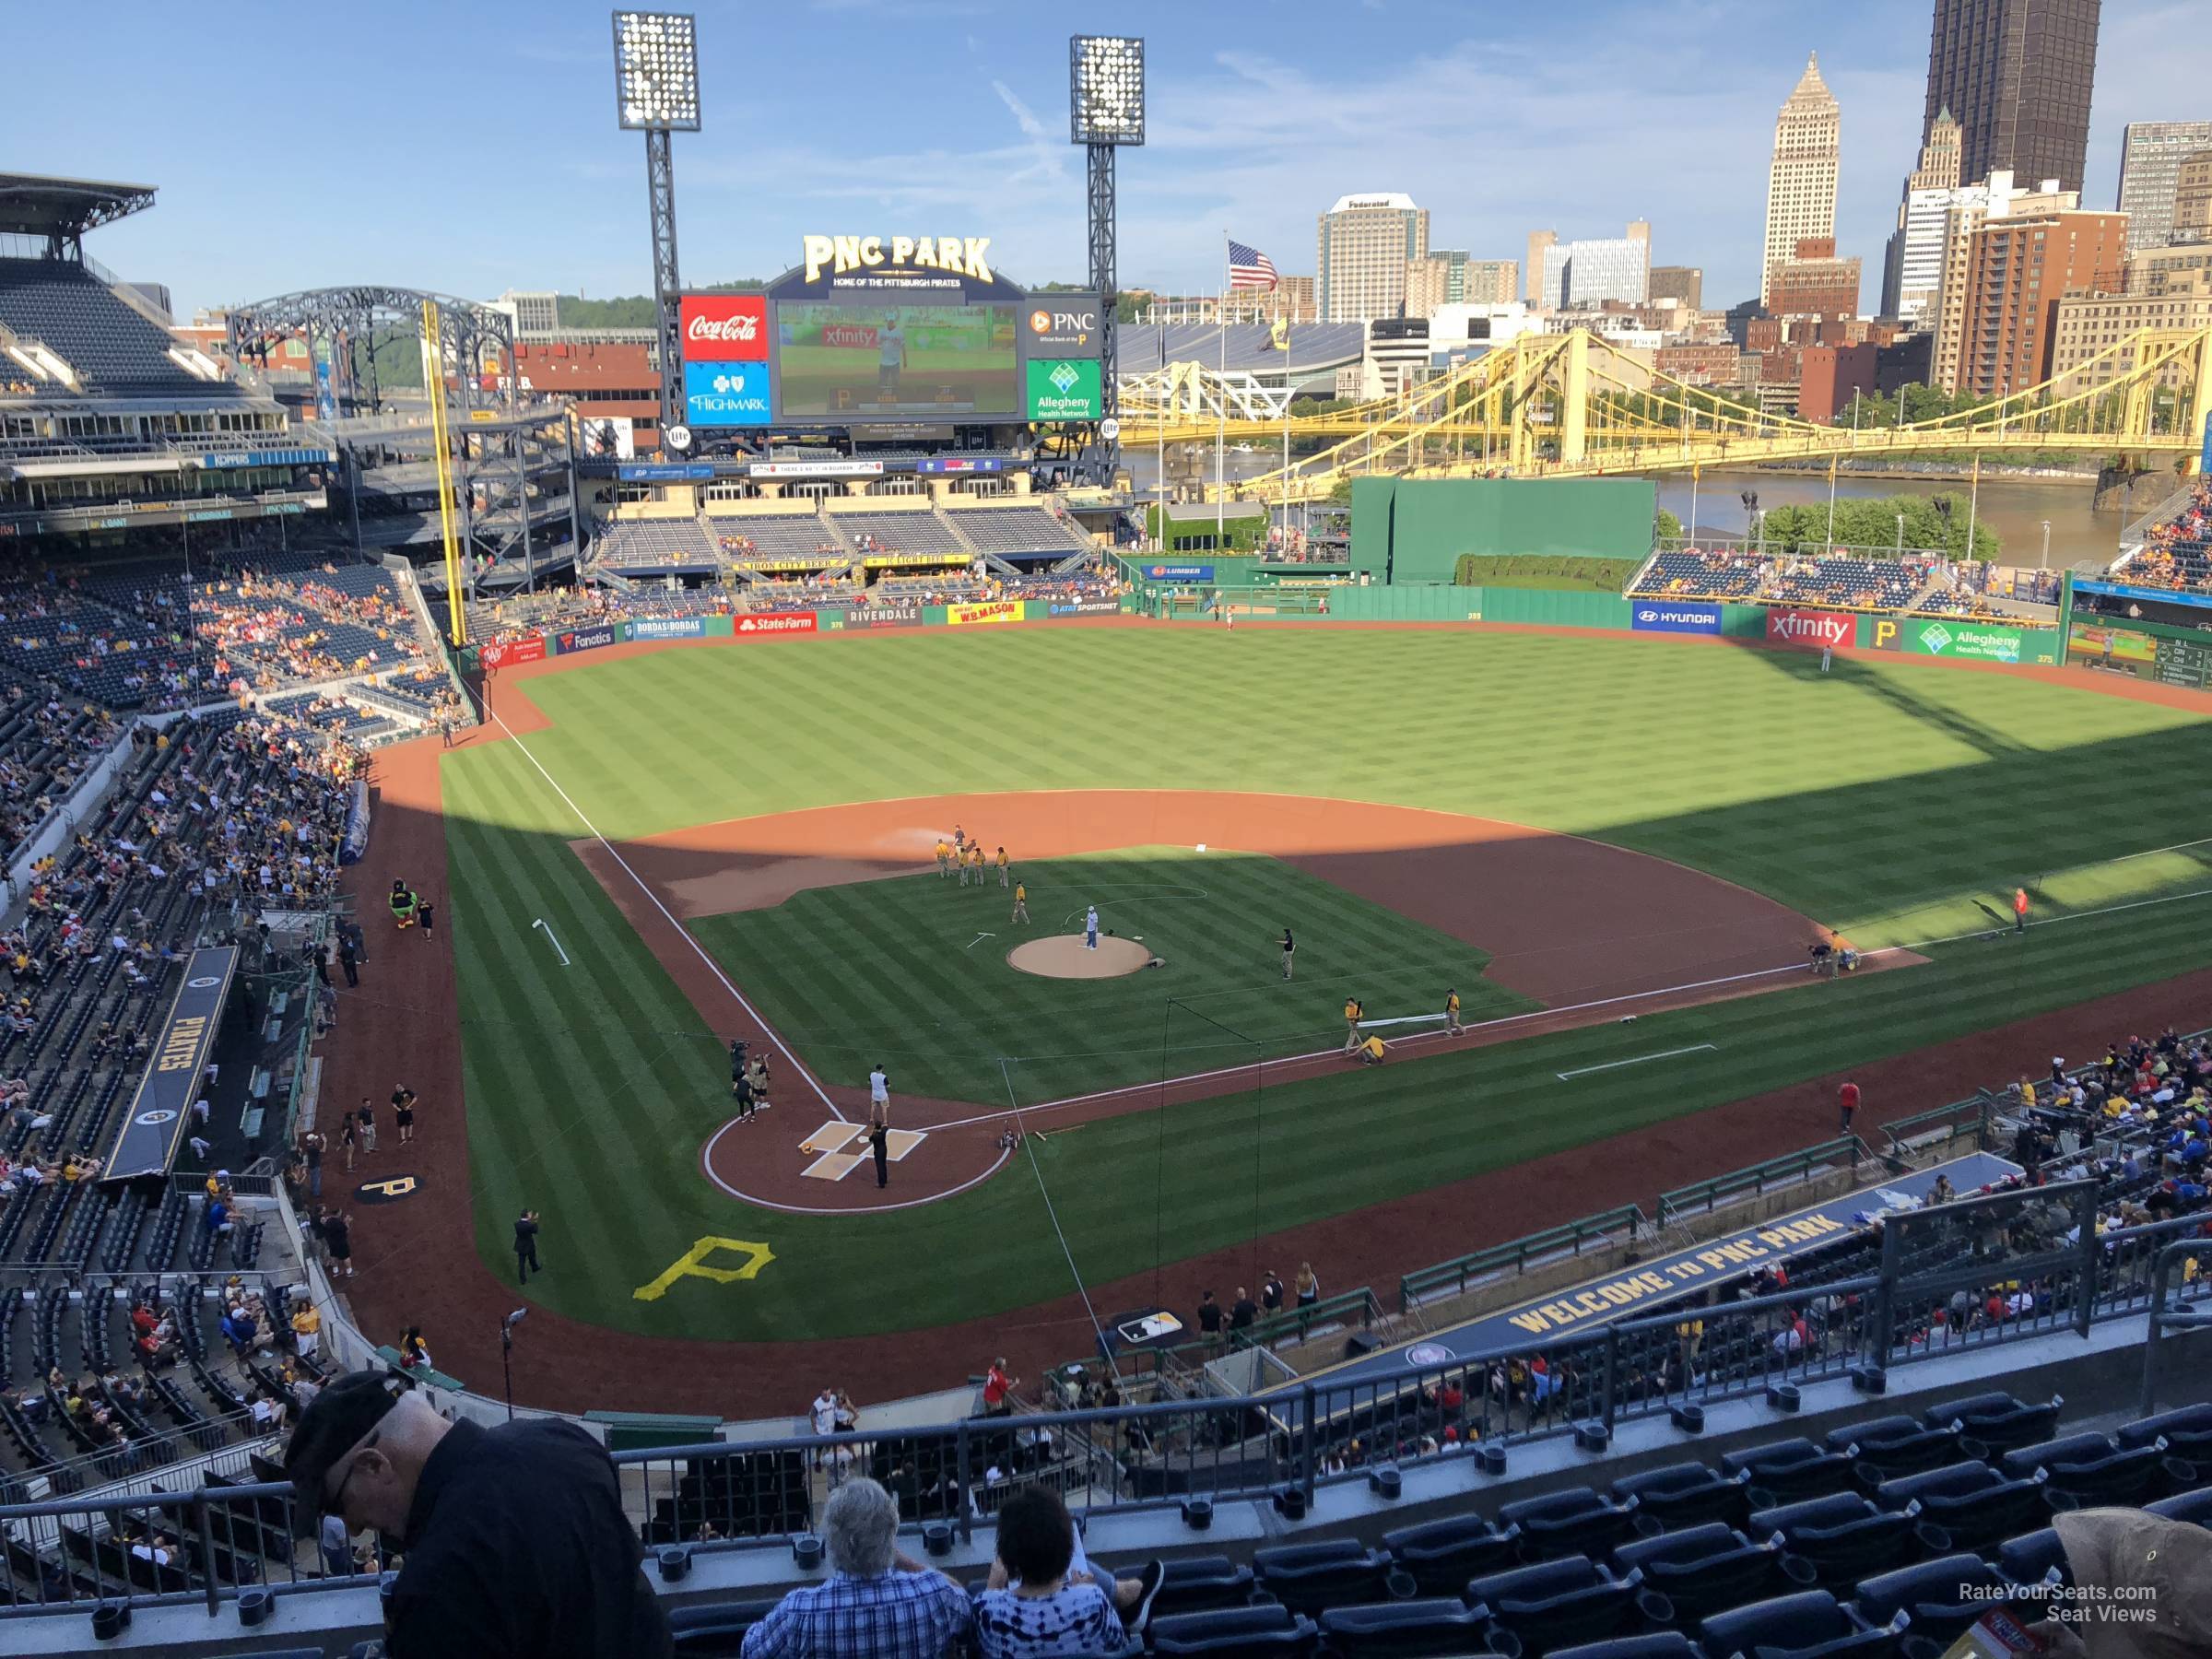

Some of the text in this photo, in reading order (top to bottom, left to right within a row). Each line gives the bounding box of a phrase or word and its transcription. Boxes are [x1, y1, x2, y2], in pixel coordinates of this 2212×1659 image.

[1348, 199, 1390, 208] Federated
[804, 235, 994, 284] PNC PARK
[833, 277, 960, 288] HOME OF THE PITTSBURGH PIRATES
[1053, 312, 1095, 330] PNC
[827, 326, 874, 346] xfinity
[697, 397, 766, 411] HIGHMARK
[1038, 396, 1090, 410] Allegheny
[1038, 409, 1060, 418] Health
[1103, 423, 1119, 434] Lite
[671, 430, 689, 442] Lite
[971, 435, 983, 445] Lite
[214, 453, 250, 465] KOPPERS
[750, 559, 831, 571] IRON CITY BEER
[978, 603, 1015, 618] MASON
[1077, 603, 1119, 612] SPORTSNET
[850, 608, 917, 622] RIVENDALE
[1661, 612, 1715, 624] HYUNDAI
[637, 622, 667, 633] BORDAS
[670, 620, 700, 631] BORDAS
[1772, 613, 1849, 643] xfinity
[574, 632, 611, 649] Fanatics
[1876, 621, 1896, 647] P
[1956, 631, 2020, 647] Allegheny
[1955, 645, 2017, 657] Health Network
[2037, 655, 2053, 664] 375
[158, 1016, 206, 1071] PIRATES
[632, 1235, 777, 1301] P
[1508, 1212, 1844, 1335] WELCOME TO PNC PARK
